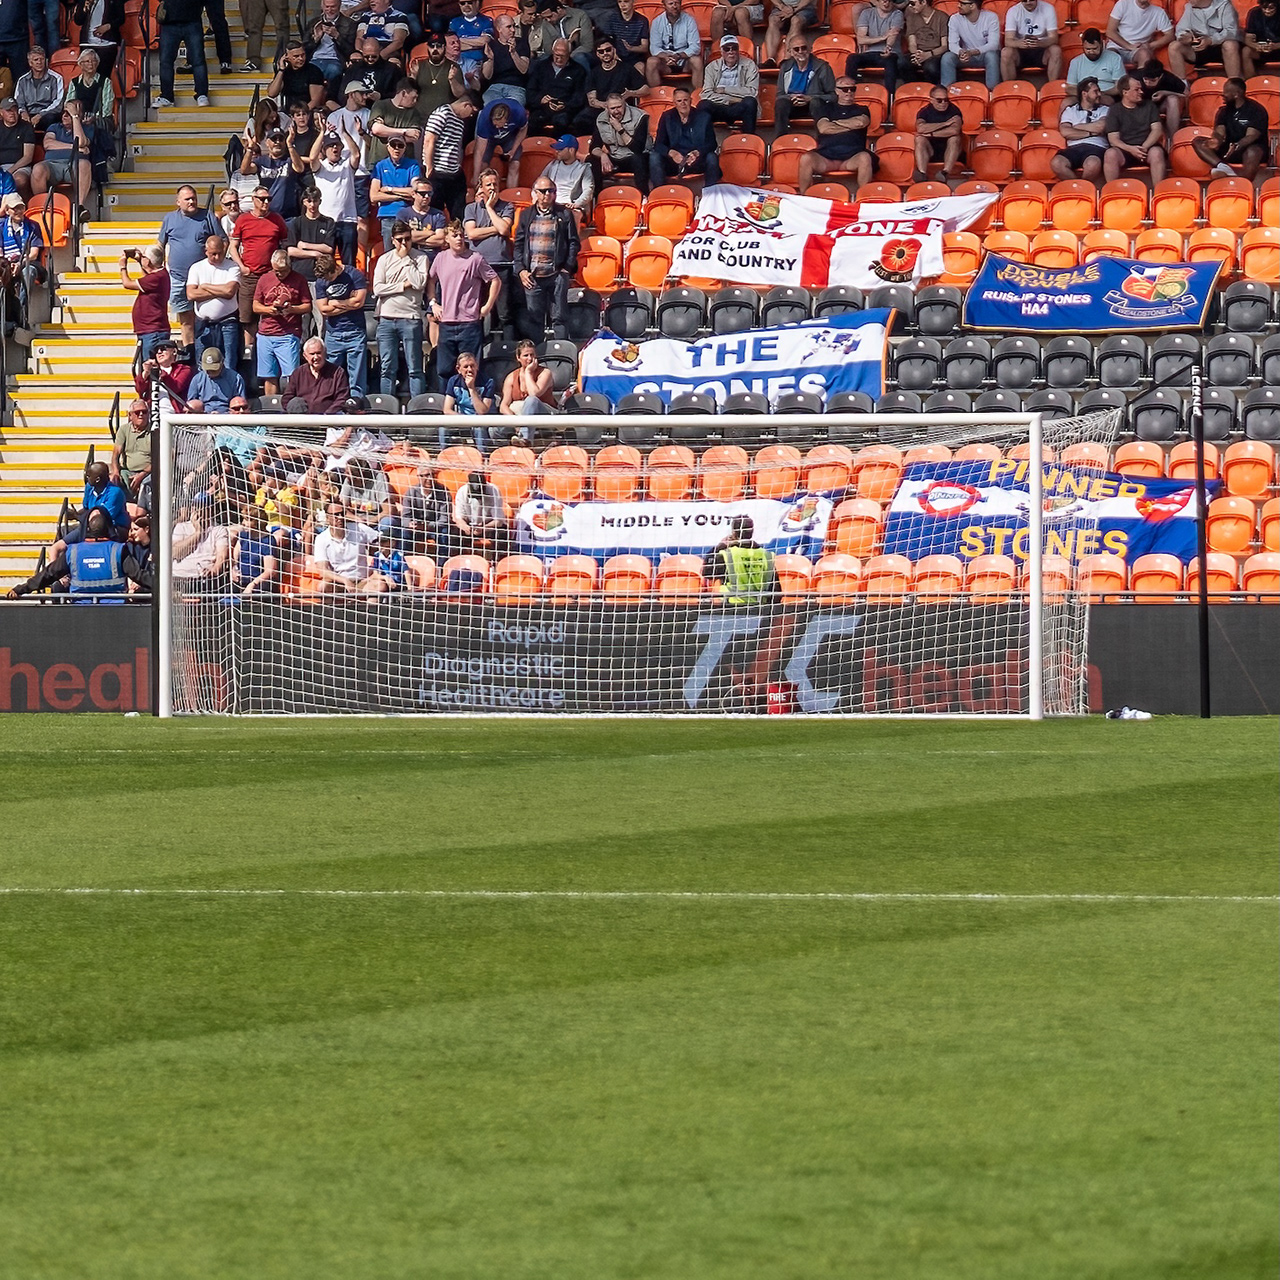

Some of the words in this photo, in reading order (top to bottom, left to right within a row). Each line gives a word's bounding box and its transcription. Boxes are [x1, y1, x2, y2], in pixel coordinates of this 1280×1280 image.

[133, 146, 141, 154] K
[110, 196, 117, 204] J
[681, 236, 715, 246] FOR
[676, 248, 712, 261] AND
[1004, 262, 1100, 281] DOUBLE
[982, 290, 1034, 302] RUISLIP
[1038, 294, 1092, 304] STONES
[1021, 302, 1049, 315] HA4
[686, 336, 780, 367] THE
[1191, 366, 1202, 416] FORZA
[601, 514, 673, 528] MIDDLE
[682, 514, 740, 528] YOUT
[488, 620, 564, 648] Rapid
[424, 652, 564, 680] Diagnostic
[862, 648, 1103, 712] healh
[418, 684, 564, 706] Healthcare
[768, 692, 787, 702] FIRE
